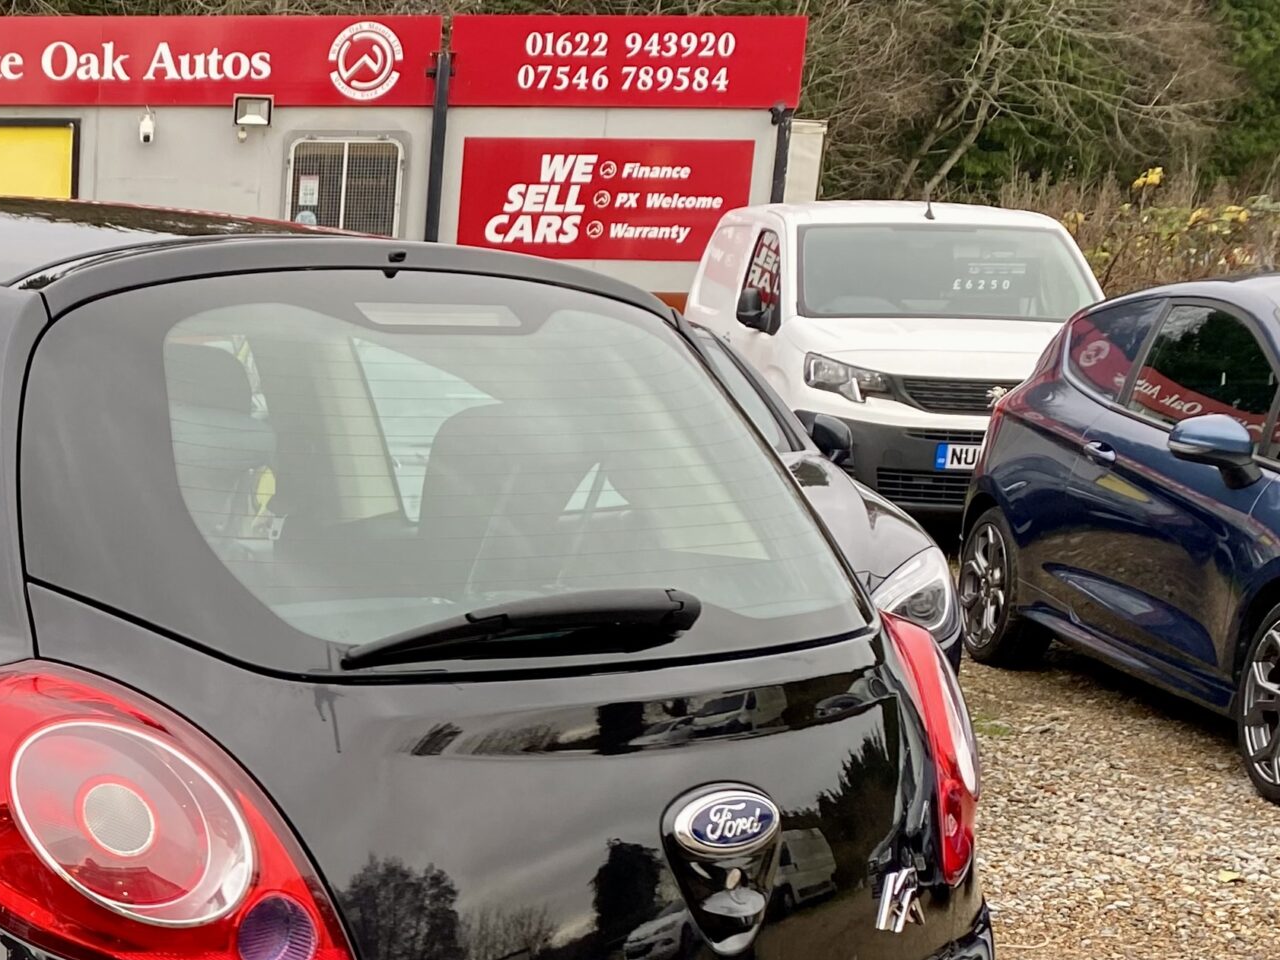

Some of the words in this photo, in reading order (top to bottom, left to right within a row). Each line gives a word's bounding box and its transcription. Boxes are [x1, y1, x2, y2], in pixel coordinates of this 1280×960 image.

[525, 32, 609, 57] 01622
[625, 32, 736, 58] 943920
[41, 41, 130, 81] Oak
[142, 41, 272, 81] Autos
[517, 64, 609, 90] 07546
[621, 66, 730, 92] 789584
[540, 154, 598, 183] WE
[621, 162, 691, 179] Finance
[503, 183, 585, 213] SELL
[614, 193, 641, 209] PX
[646, 193, 723, 209] Welcome
[484, 215, 581, 244] CARS
[610, 223, 691, 244] Warranty
[952, 278, 1010, 291] £6250
[949, 447, 981, 465] NU
[706, 802, 762, 841] Ford
